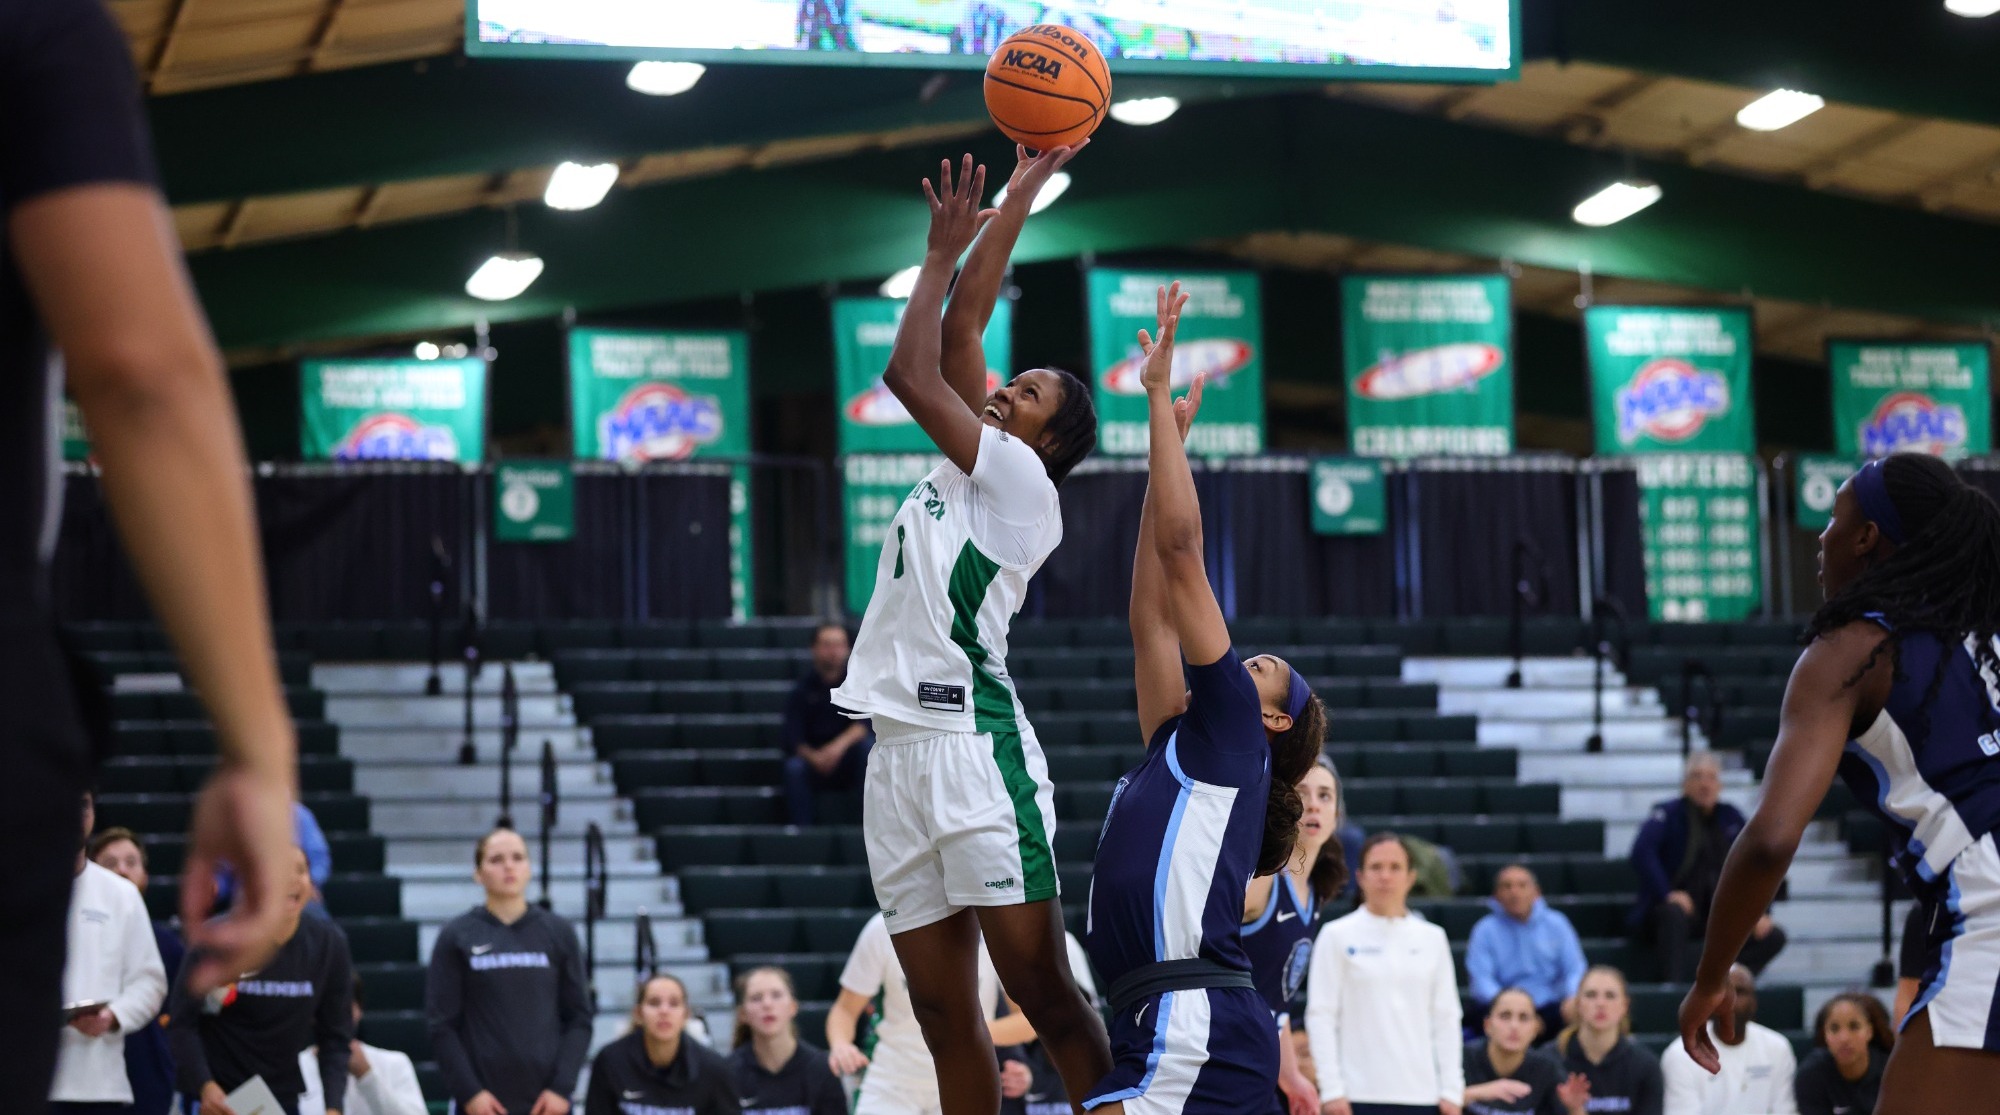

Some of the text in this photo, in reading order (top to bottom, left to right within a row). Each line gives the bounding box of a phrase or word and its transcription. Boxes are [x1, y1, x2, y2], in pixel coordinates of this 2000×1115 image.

[1002, 49, 1061, 79] NCAA
[1102, 421, 1260, 454] CHPIONS
[985, 877, 1014, 889] capelli
